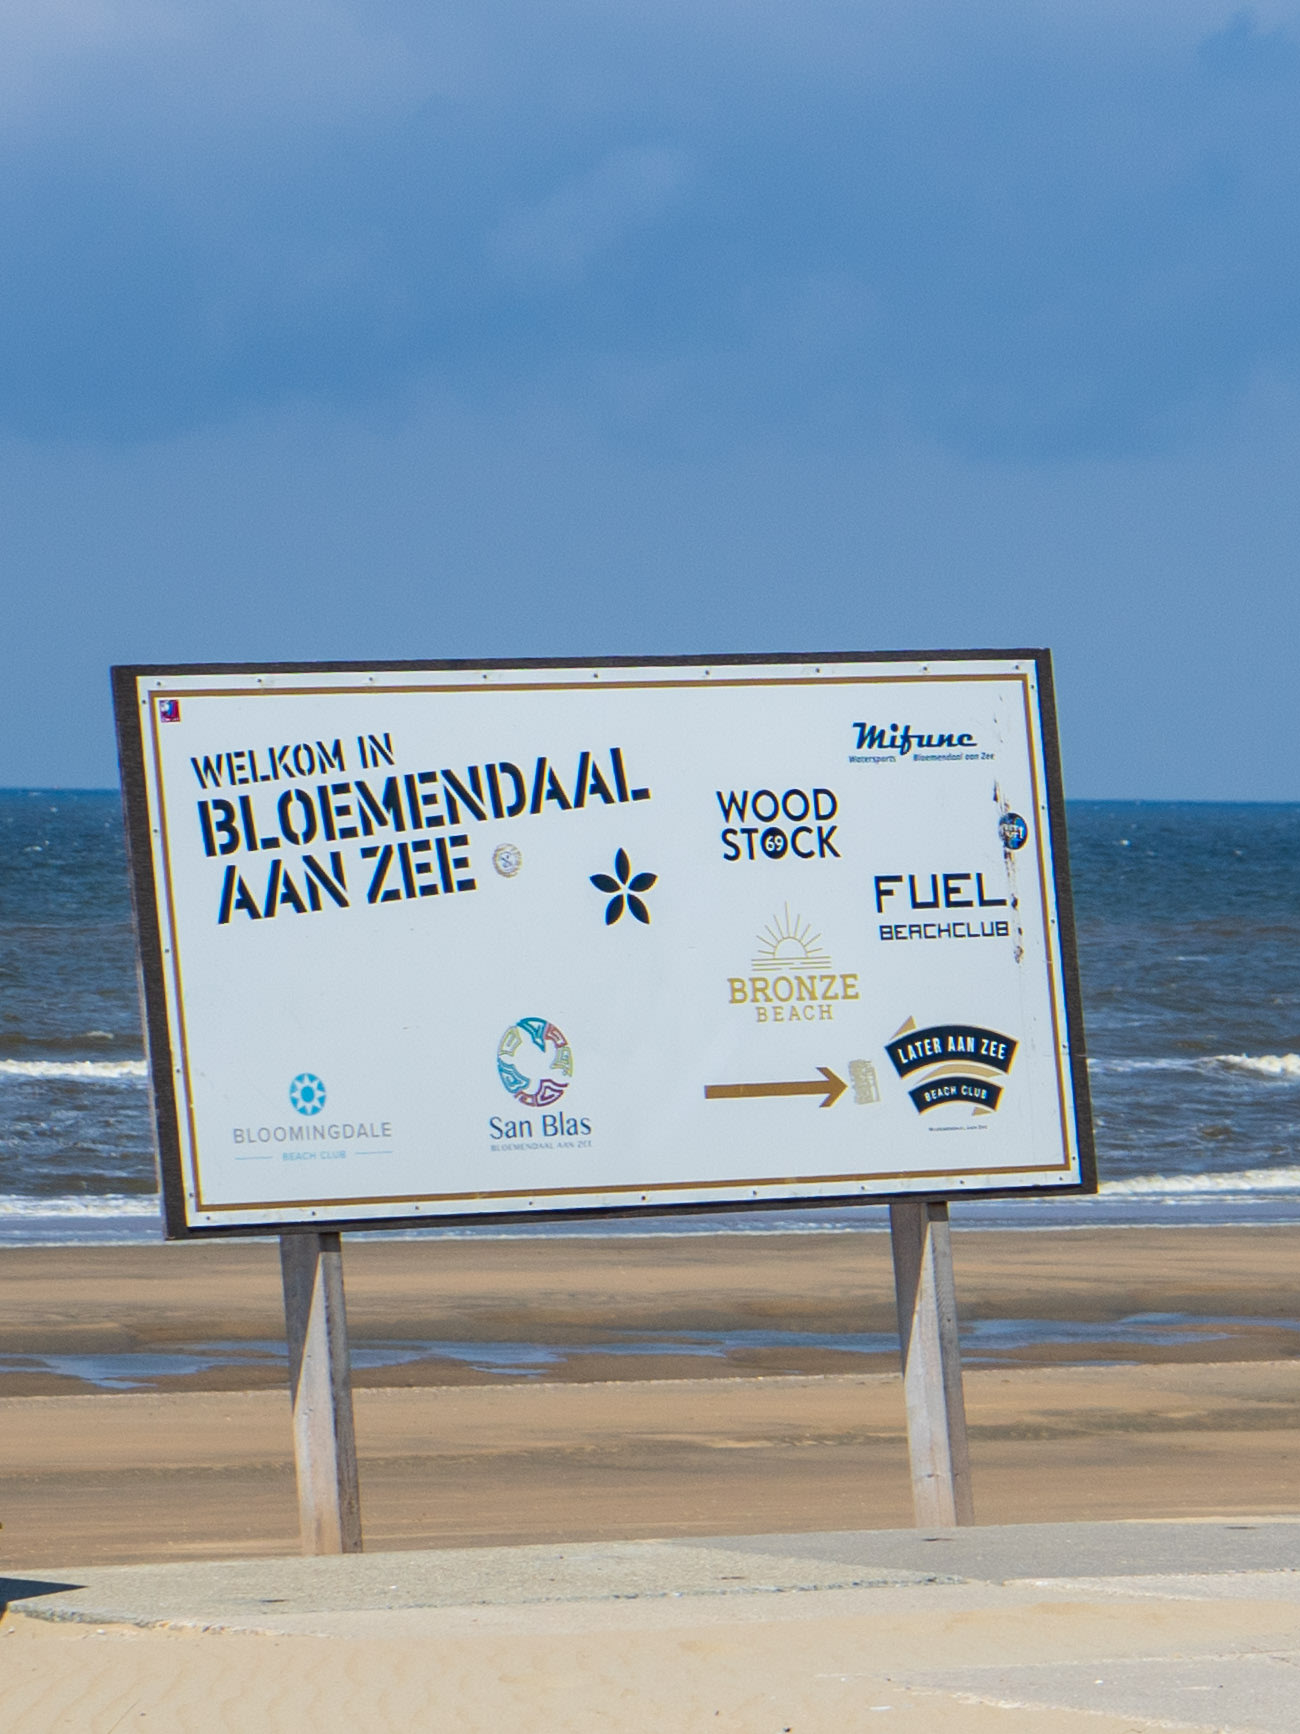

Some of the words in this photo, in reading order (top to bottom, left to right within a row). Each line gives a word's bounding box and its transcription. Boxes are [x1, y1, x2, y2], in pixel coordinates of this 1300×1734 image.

[190, 738, 346, 789] WELKOM
[357, 732, 397, 768] IN
[197, 747, 652, 858] BLOEMENDAAL
[716, 788, 839, 823] WOOD
[218, 850, 351, 925] AAN
[360, 834, 478, 905] ZEE
[874, 872, 1008, 913] FUEL
[879, 921, 1010, 941] BEACHCLUB
[726, 973, 861, 1005] BRONZE
[756, 1004, 834, 1023] BEACH
[897, 1036, 942, 1063] LATER
[948, 1035, 975, 1053] AAN
[981, 1039, 1007, 1059] ZEE
[924, 1085, 957, 1102] BEACH
[961, 1085, 988, 1100] CLUB
[233, 1122, 392, 1144] BLOOMINGDALE
[489, 1116, 533, 1140] San
[542, 1111, 592, 1137] Blas
[282, 1151, 317, 1161] BEACH
[319, 1150, 347, 1160] CLUB
